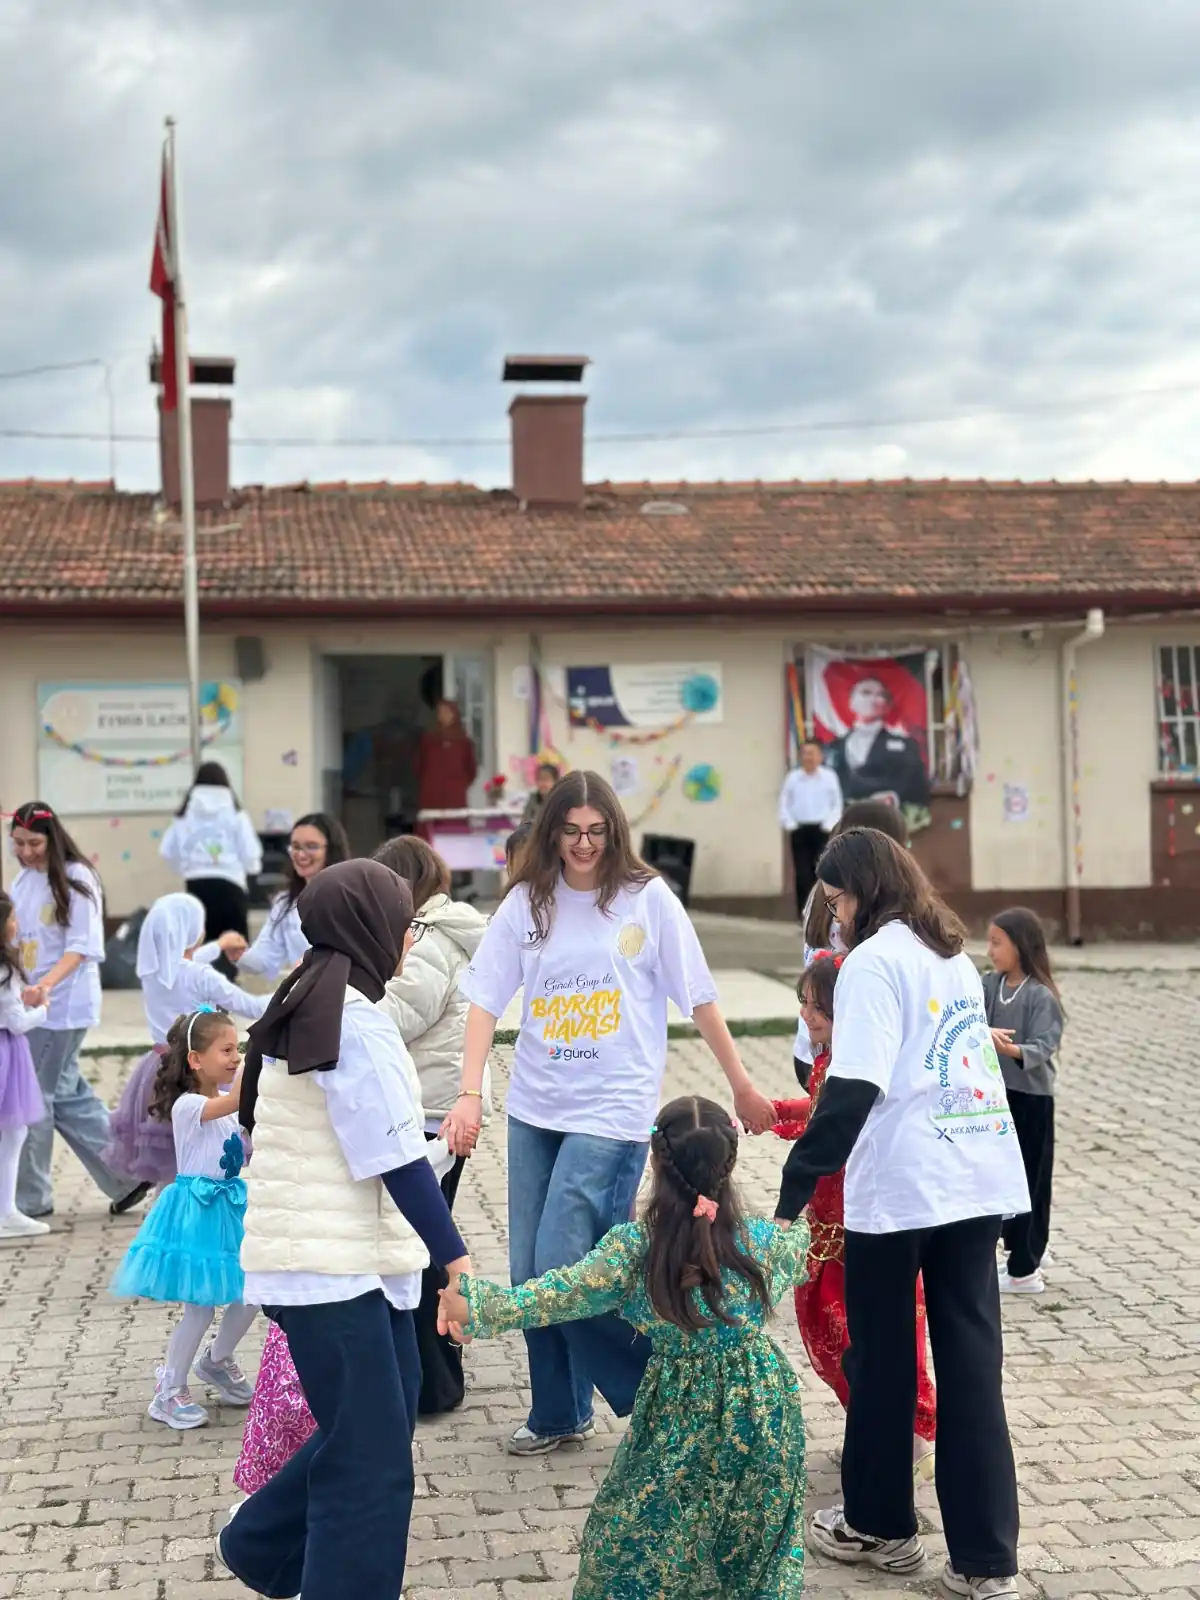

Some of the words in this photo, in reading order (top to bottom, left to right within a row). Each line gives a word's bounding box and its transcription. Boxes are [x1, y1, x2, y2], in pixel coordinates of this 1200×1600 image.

[531, 988, 621, 1020] BAYRAM
[563, 1047, 600, 1061] gürok
[936, 1051, 951, 1088] çocuk
[950, 1123, 991, 1135] AKKAYMAK
